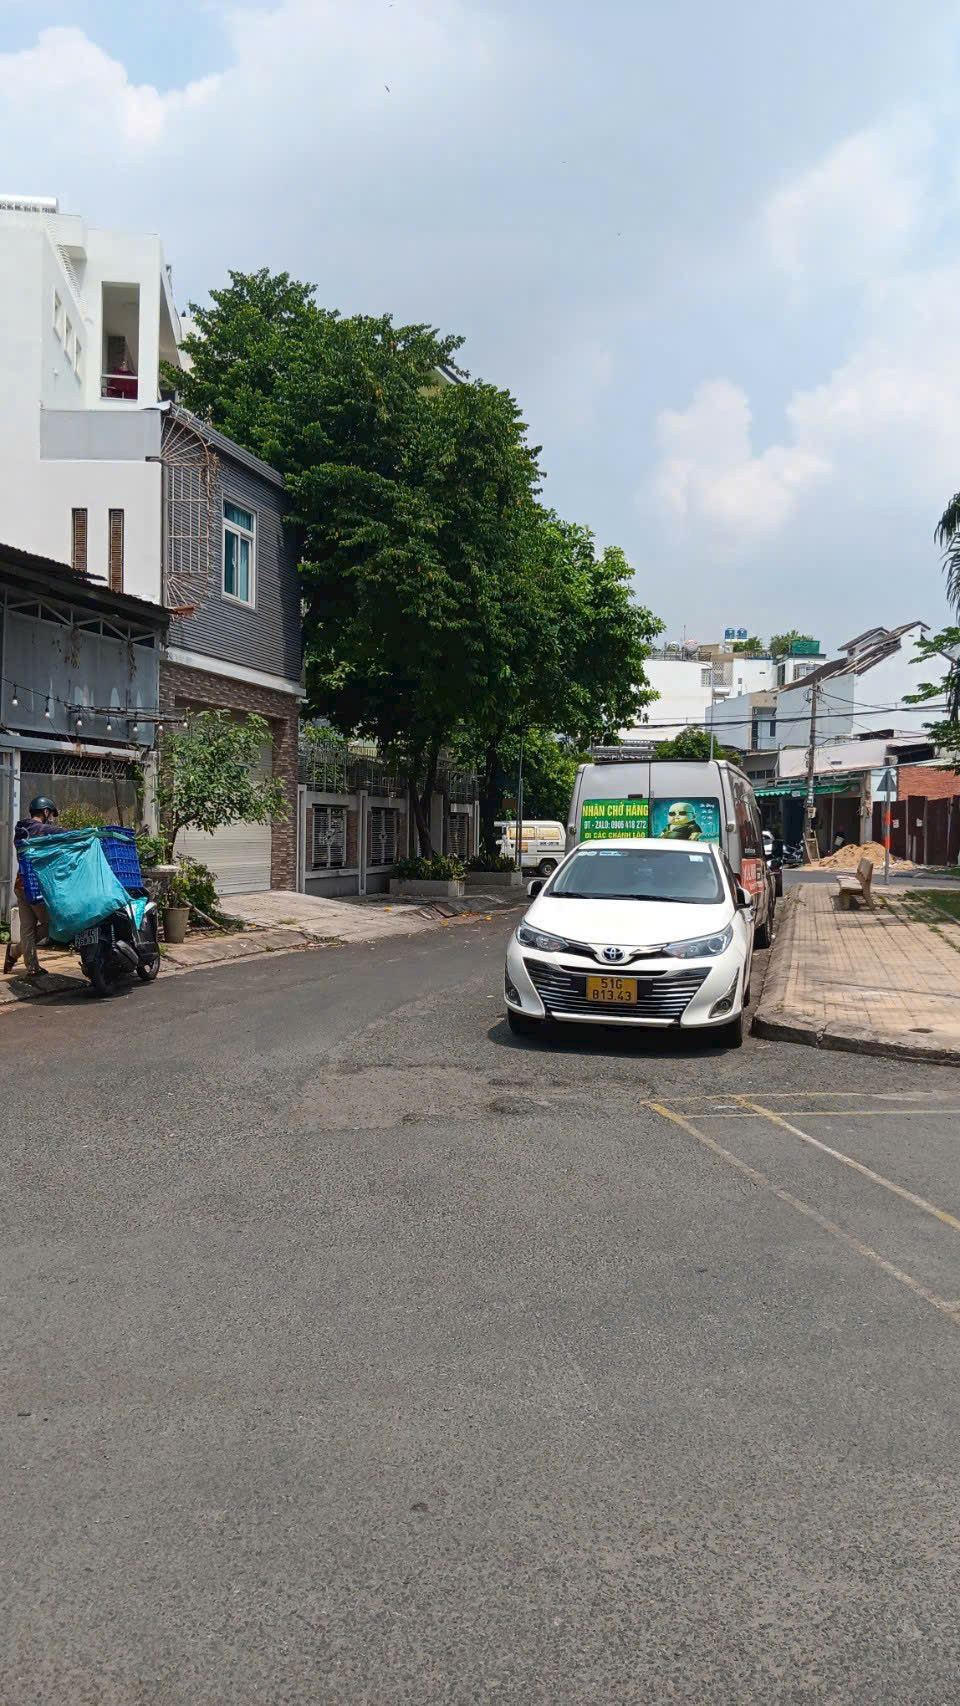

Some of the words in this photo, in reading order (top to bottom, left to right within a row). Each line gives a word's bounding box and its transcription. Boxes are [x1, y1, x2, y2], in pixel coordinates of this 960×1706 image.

[583, 803, 605, 819] NHẬN
[636, 820, 647, 829] 272
[601, 978, 623, 989] 51G
[592, 989, 632, 1001] 813.43
